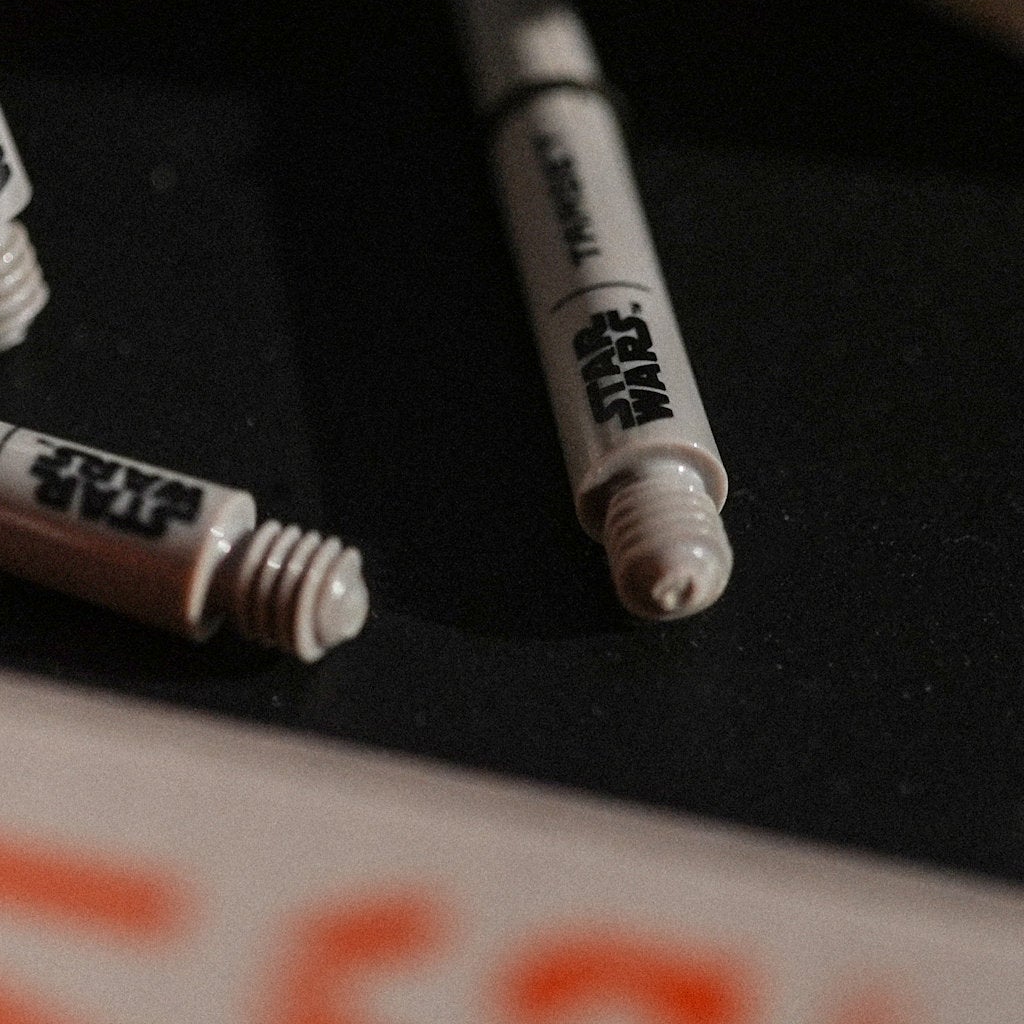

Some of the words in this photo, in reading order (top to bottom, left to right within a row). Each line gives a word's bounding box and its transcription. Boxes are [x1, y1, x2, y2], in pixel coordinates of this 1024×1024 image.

[573, 310, 638, 431] STAR
[606, 309, 674, 427] WARS
[31, 466, 200, 541] STAR
